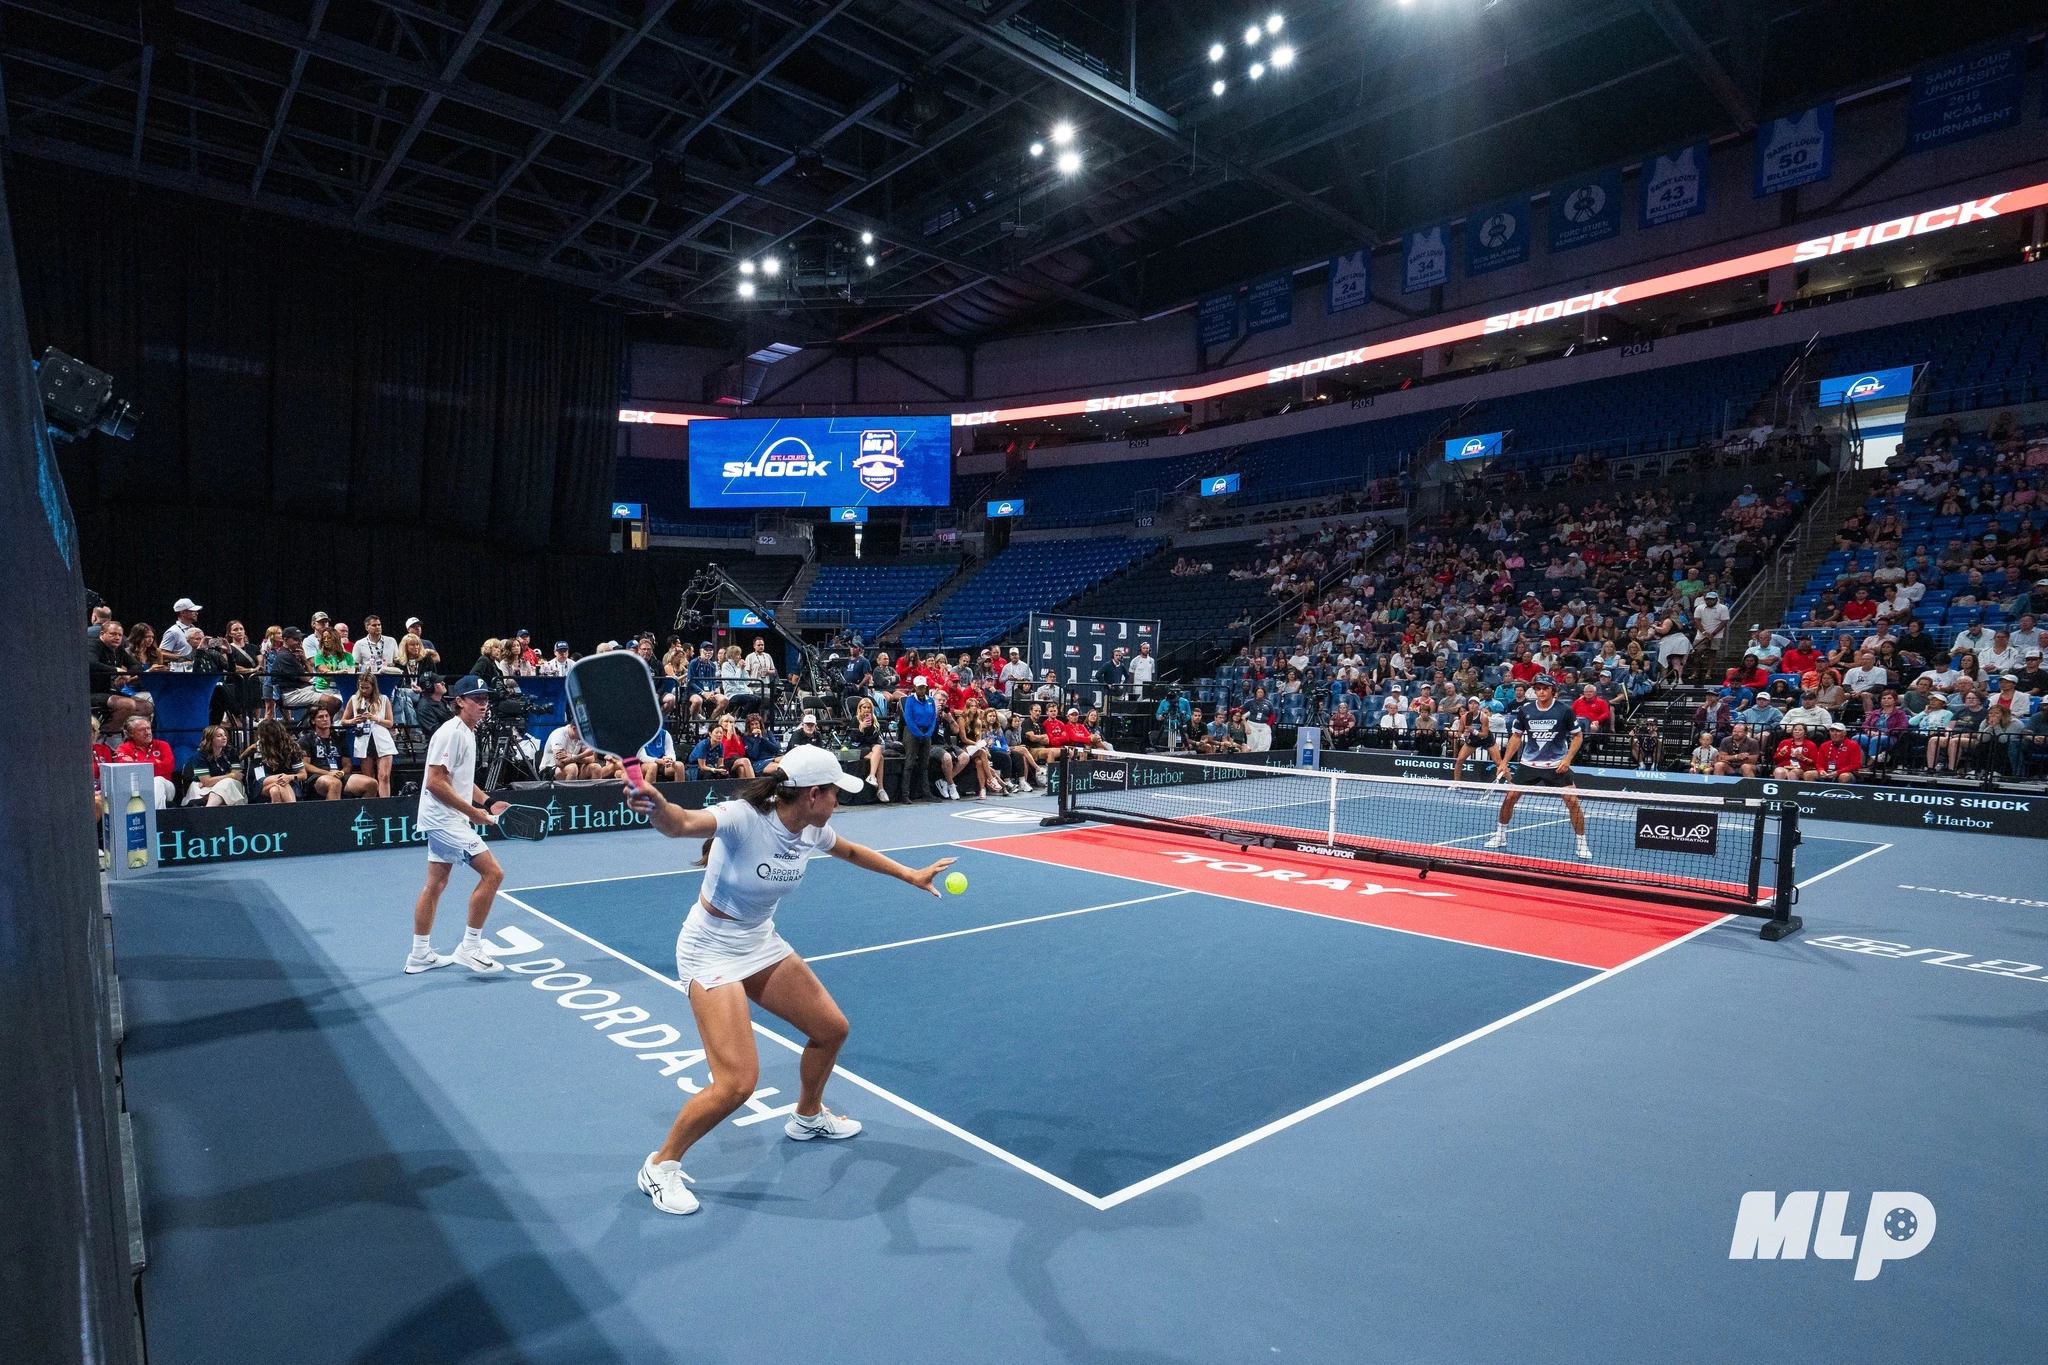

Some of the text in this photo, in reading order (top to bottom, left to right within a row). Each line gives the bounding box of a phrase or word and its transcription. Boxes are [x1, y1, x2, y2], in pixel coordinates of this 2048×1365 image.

[1925, 50, 2011, 84] SAINT LOUIS
[1925, 62, 2009, 96] UNIVERSITY
[1943, 103, 1982, 120] NCAA
[1914, 106, 2012, 142] TOURNAMENT
[1766, 137, 1821, 159] SAINT LOUIS
[1779, 149, 1808, 169] 50
[1767, 161, 1818, 181] BILLIKENS
[1650, 174, 1696, 193] SAINT LOUIS
[1660, 185, 1684, 201] 43
[1650, 197, 1694, 214] BILLIKENS
[1793, 191, 2012, 263] SHOCK
[1418, 259, 1434, 273] 34
[1249, 283, 1289, 301] BASKETBALL
[1342, 281, 1356, 294] 24
[1260, 306, 1277, 316] NCAA
[1483, 285, 1626, 335] SHOCK
[1249, 312, 1288, 328] TOURNAMENT
[1623, 342, 1651, 356] 204
[1267, 347, 1368, 383] SHOCK
[1085, 390, 1180, 412] SHOCK
[1353, 398, 1373, 409] 203
[951, 411, 999, 426] OCK
[863, 439, 894, 454] MLP
[1130, 439, 1148, 448] 202
[722, 461, 832, 477] SHOCK
[1137, 517, 1152, 527] 102
[1532, 731, 1557, 739] SLICE
[1394, 759, 1474, 771] CHICAGO SLCE
[1142, 767, 1184, 786] Harbor
[1597, 768, 1605, 776] 2
[1635, 770, 1668, 780] WINS
[1763, 783, 1779, 796] 6
[1798, 790, 1865, 800] SHOCK
[1873, 792, 2031, 812] ST.LOUIS SHOCK
[568, 801, 650, 831] Harbo
[1936, 815, 1994, 830] Harbor
[156, 826, 288, 861] Harbor
[1639, 833, 1709, 844] ALKALINE HYDRATION
[773, 852, 800, 860] SHOCK
[1296, 844, 1356, 860] DOMINATOR
[772, 868, 800, 876] SPORTS
[1172, 854, 1414, 897] TORAY
